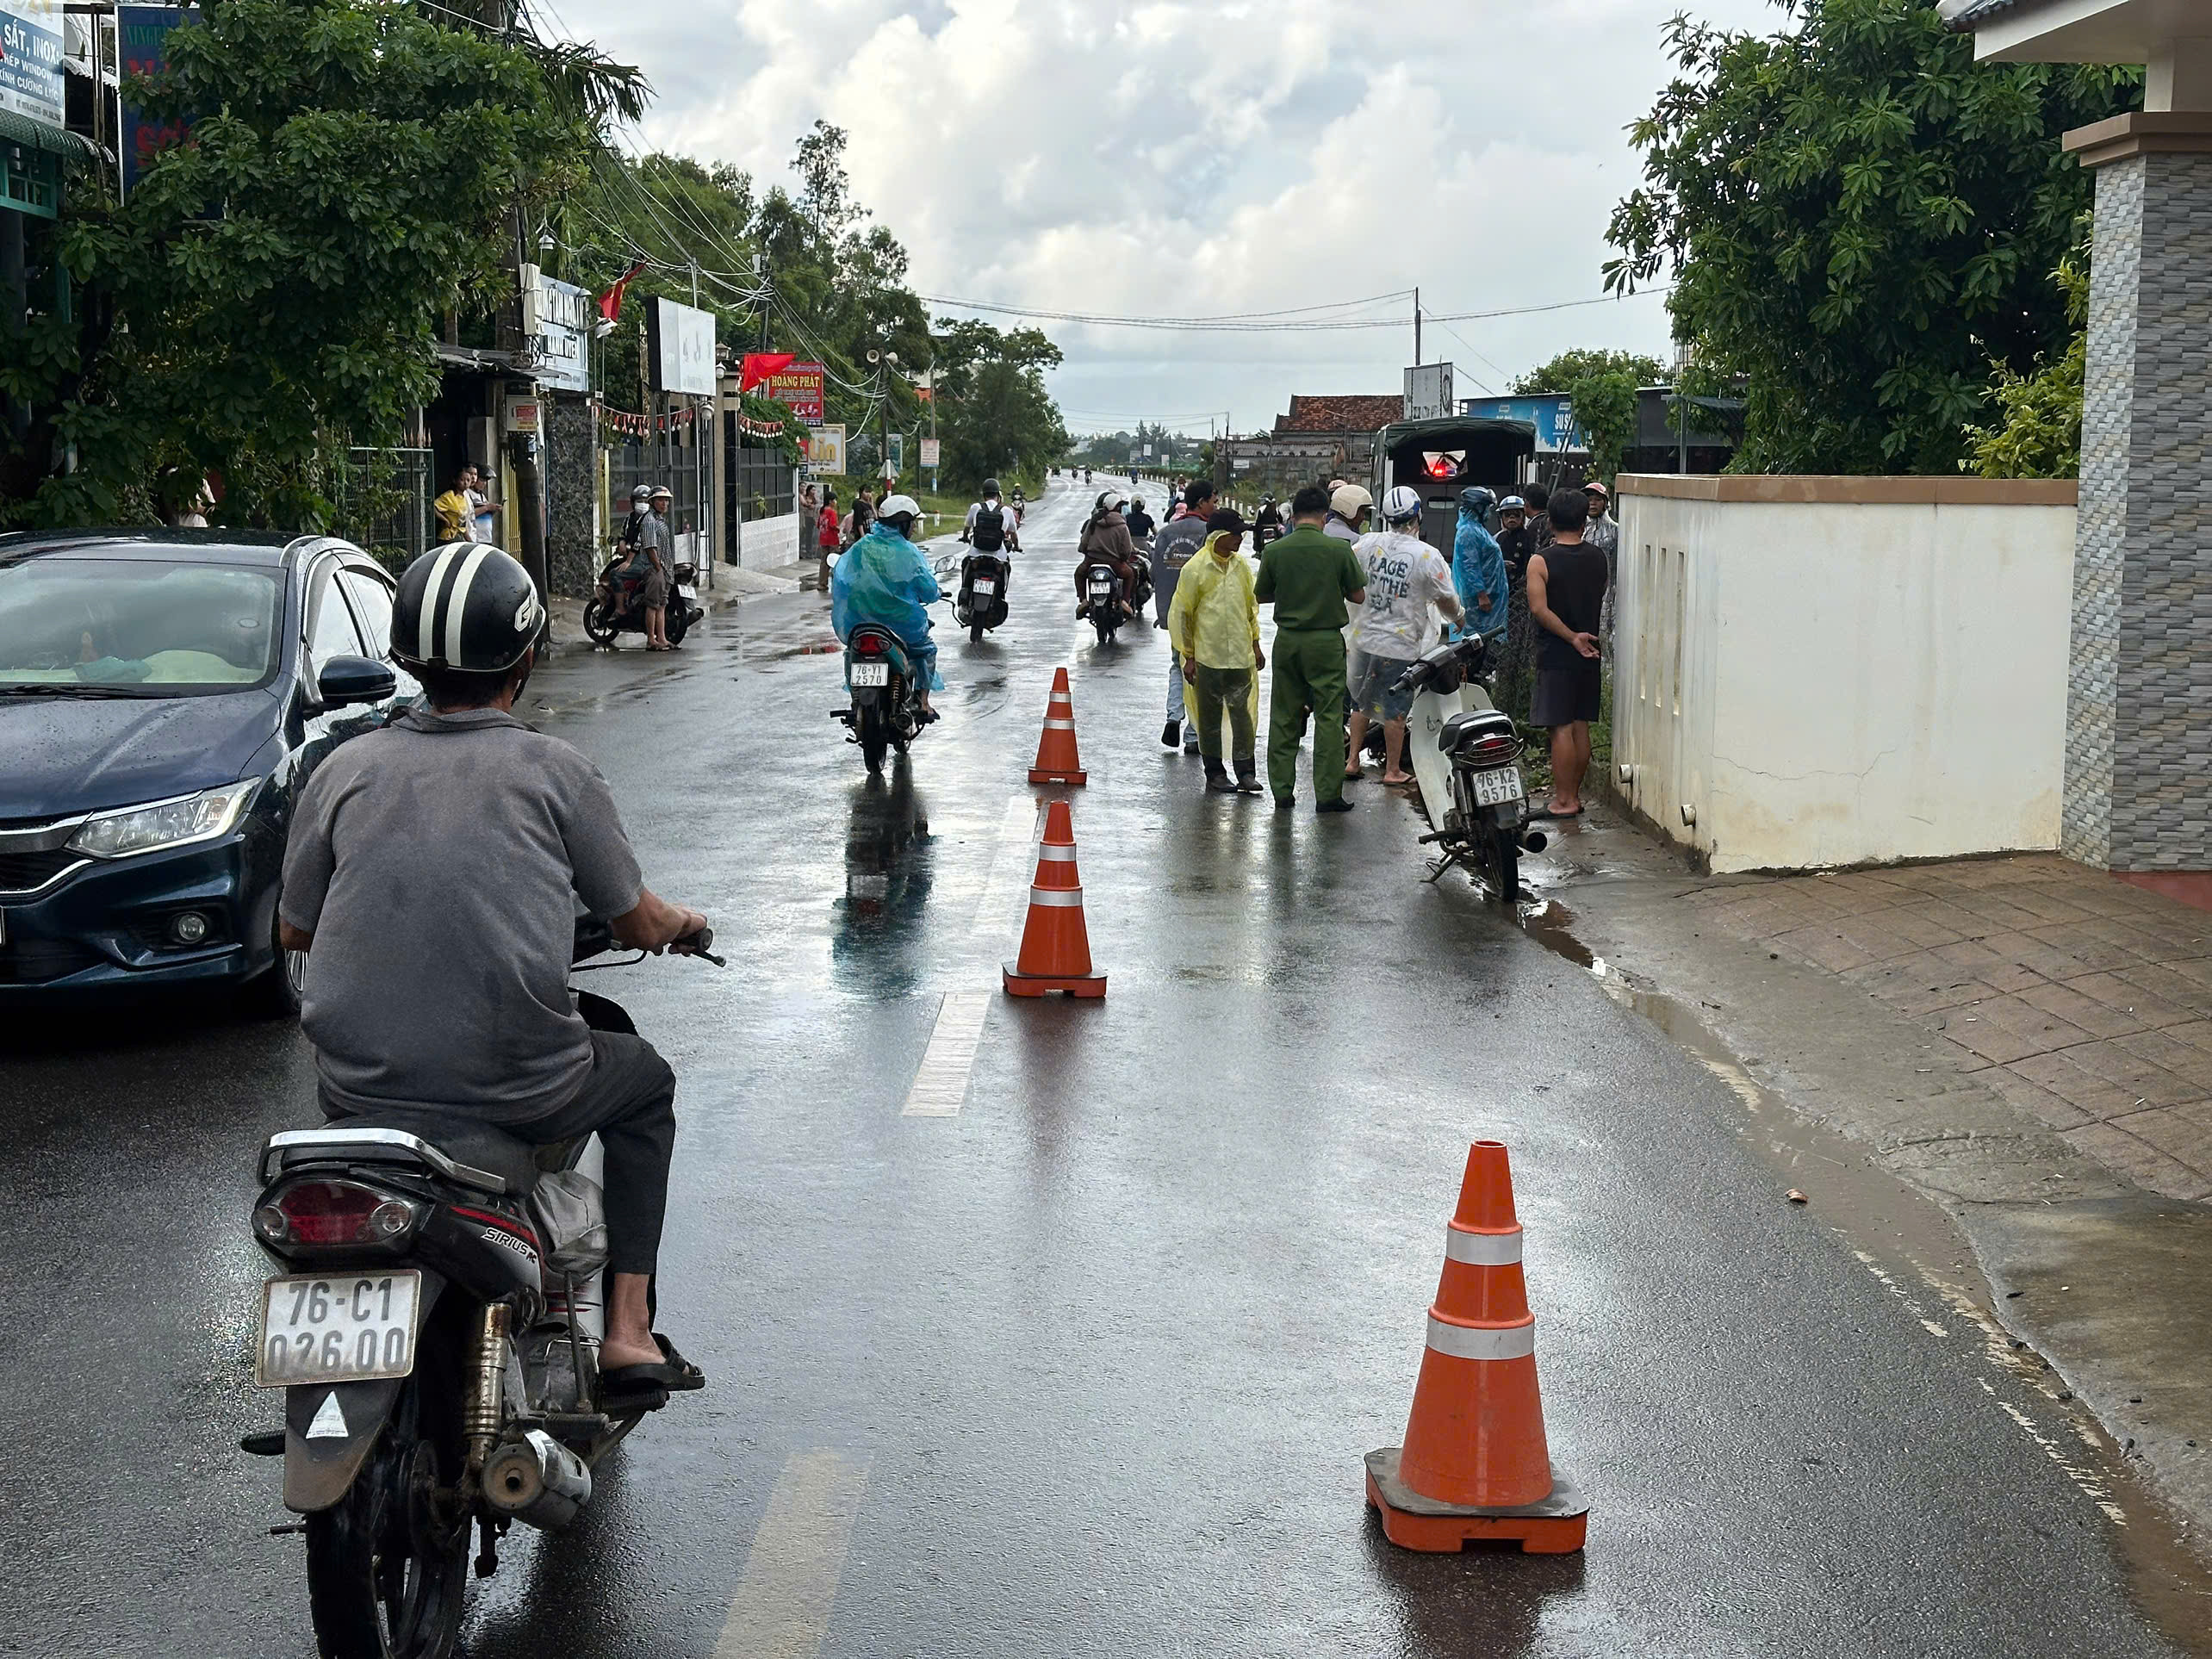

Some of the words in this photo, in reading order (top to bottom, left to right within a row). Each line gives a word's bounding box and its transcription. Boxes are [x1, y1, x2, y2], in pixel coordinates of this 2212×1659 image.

[22, 59, 53, 82] WINDOW
[856, 665, 881, 674] 76-Y1
[855, 675, 882, 685] 2570
[1477, 768, 1515, 788] 76-K2
[1482, 784, 1518, 803] 9576
[480, 1227, 530, 1256] SIRIUS
[289, 1278, 393, 1326] 76-C1
